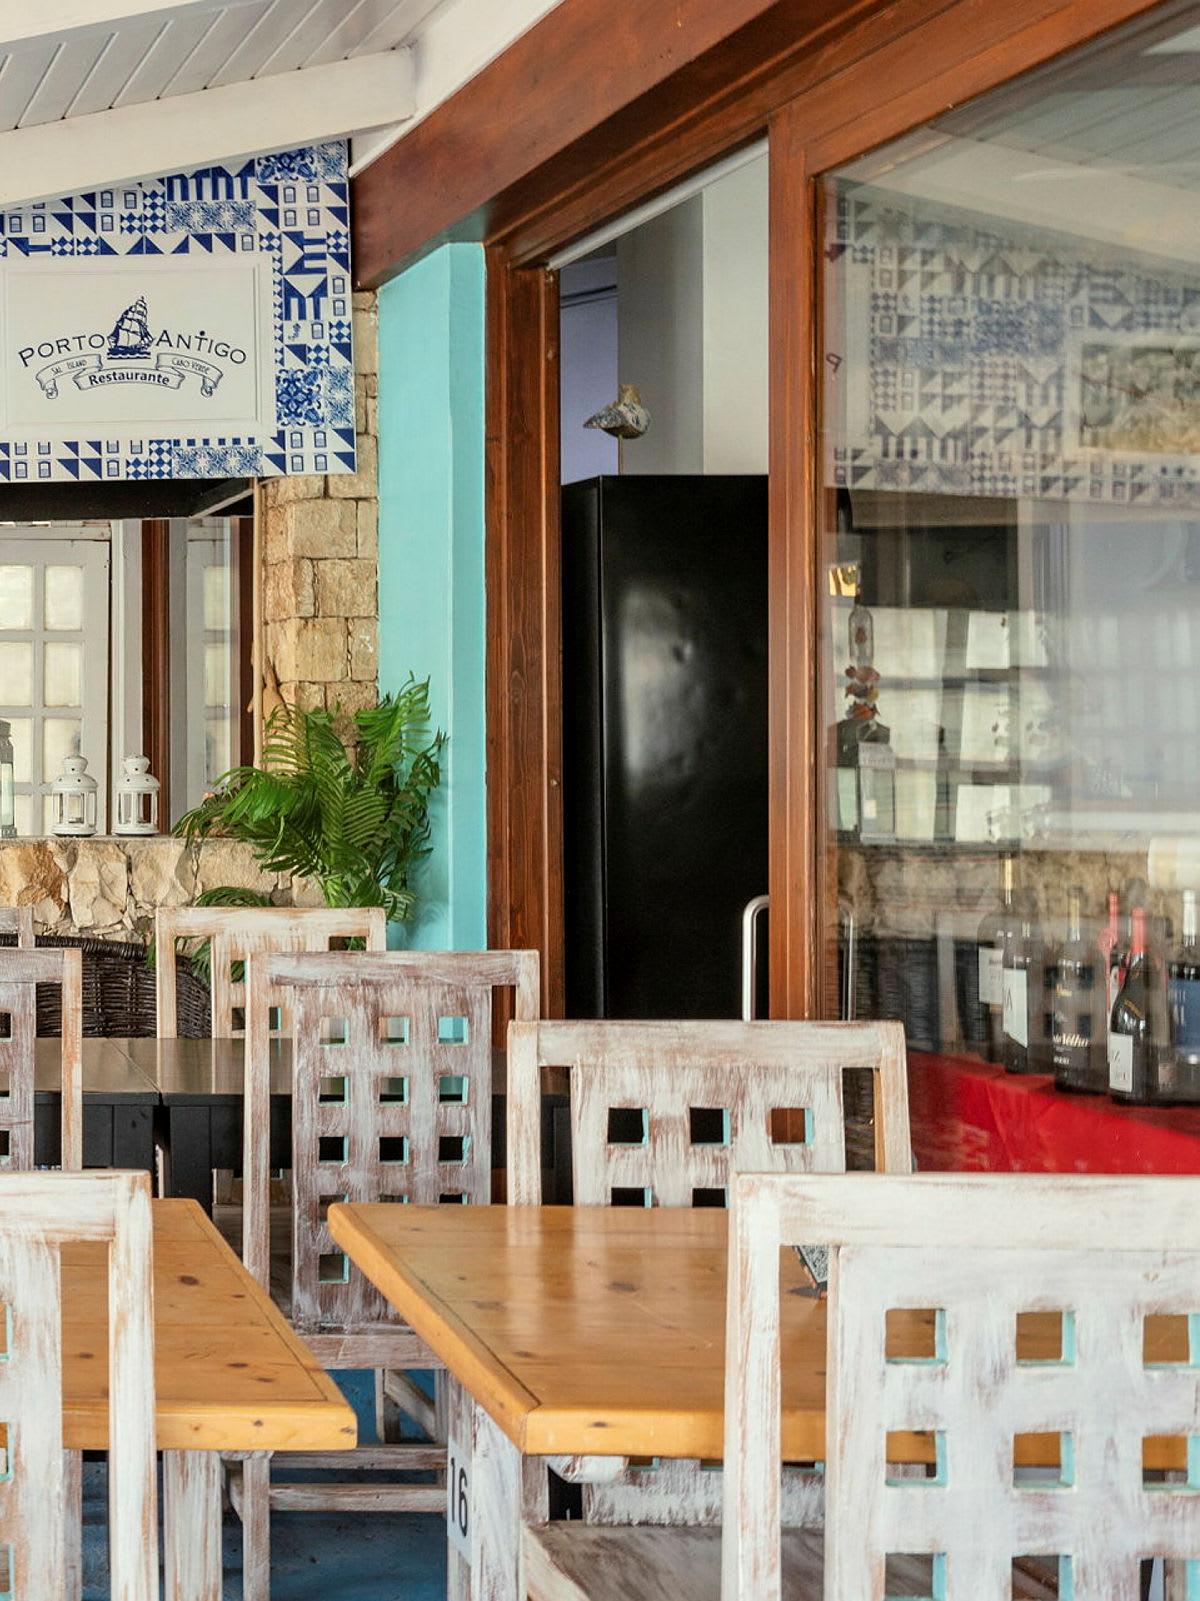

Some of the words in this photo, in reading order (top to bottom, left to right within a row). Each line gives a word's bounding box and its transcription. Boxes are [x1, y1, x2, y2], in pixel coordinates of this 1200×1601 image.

[17, 333, 105, 367] PORTO
[89, 372, 170, 386] Restaurante
[451, 1457, 468, 1538] 16
